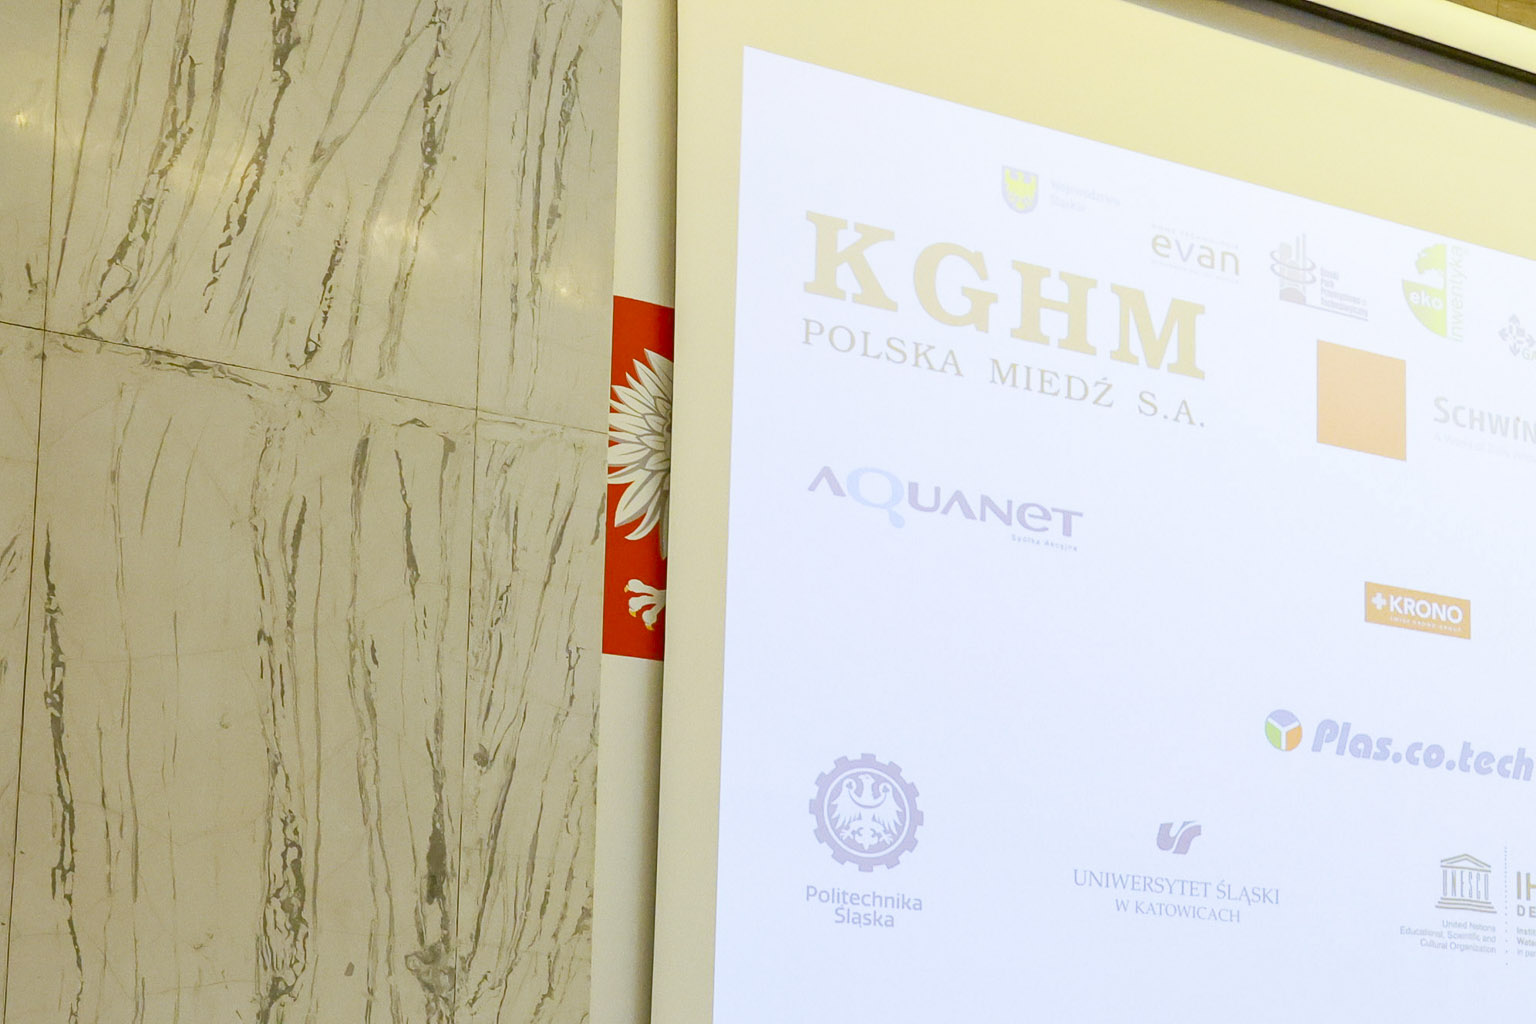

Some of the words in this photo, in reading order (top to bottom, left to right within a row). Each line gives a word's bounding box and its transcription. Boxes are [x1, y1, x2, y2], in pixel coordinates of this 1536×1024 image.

[1151, 234, 1239, 276] evan
[803, 210, 1205, 380] KGHM
[1408, 288, 1444, 311] eko
[802, 317, 964, 377] POLSKA
[989, 357, 1115, 408] MIEDŹ
[1136, 389, 1206, 428] S.A.
[1389, 594, 1463, 624] KRONO
[1311, 718, 1535, 782] Plas.co.tech
[805, 884, 924, 913] Politechnika
[1072, 868, 1212, 899] UNIWERSYTET
[1215, 878, 1281, 907] ŚLĄSKI
[1441, 869, 1491, 901] UNESCO
[834, 906, 896, 930] Śląska
[1114, 898, 1131, 913] W
[1133, 900, 1241, 923] KATOWICACH
